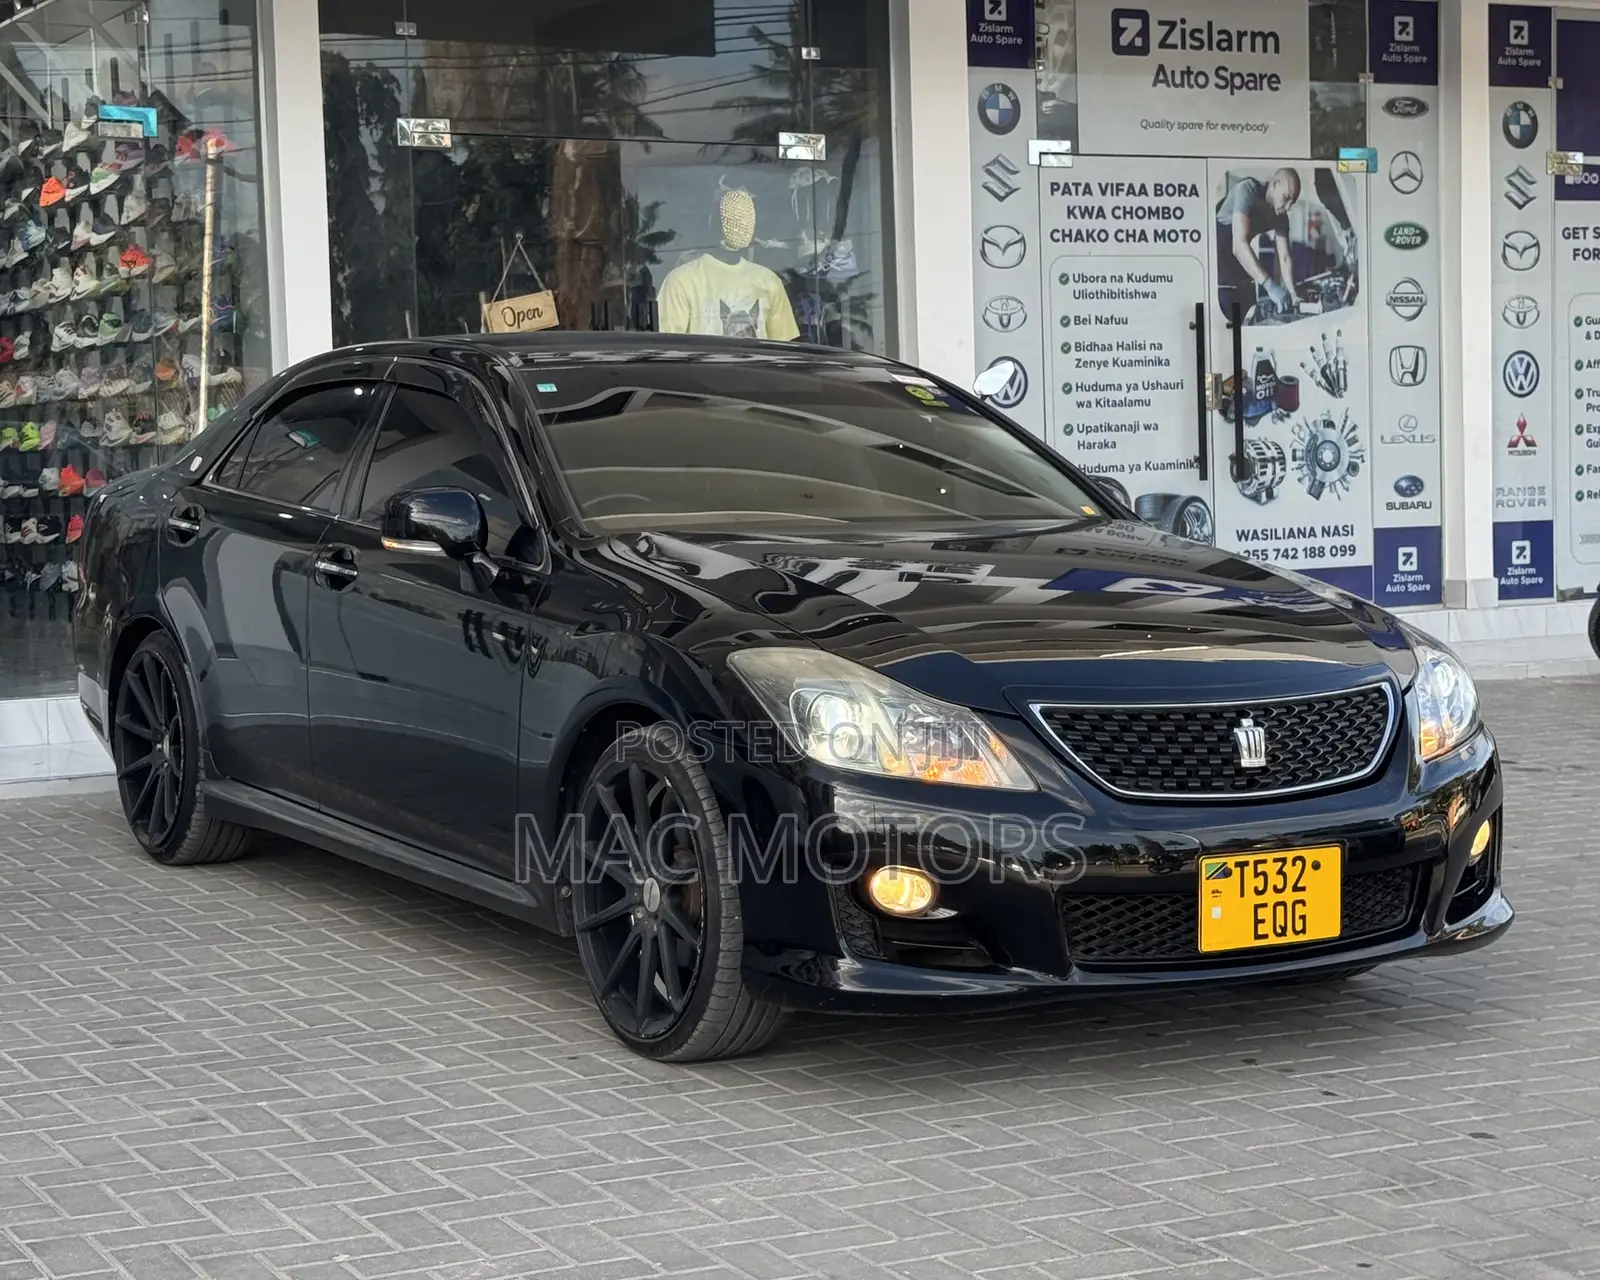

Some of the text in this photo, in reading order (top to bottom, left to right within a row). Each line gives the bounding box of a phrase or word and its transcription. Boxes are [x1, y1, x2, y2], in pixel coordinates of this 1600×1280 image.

[979, 22, 1014, 34] Zislarm
[970, 33, 1024, 46] Auto Spare
[1156, 18, 1280, 54] Zislarm
[1381, 52, 1428, 64] Auto Spare
[1152, 64, 1281, 96] Auto Spare
[1140, 118, 1270, 134] Quality spare for everybody
[1050, 182, 1200, 198] PATA VIFAA BORA
[1066, 205, 1185, 221] KWA CHOMBO
[1049, 229, 1202, 244] CHAKO CHA MOTO
[1393, 227, 1415, 237] LAND
[1562, 226, 1589, 241] GET
[1395, 236, 1422, 246] ROVER
[1572, 247, 1600, 262] FOR
[1072, 273, 1174, 284] Ubora na Kudumu
[1072, 288, 1157, 300] Uliothibitishwa
[1389, 295, 1424, 304] NISSAN
[501, 306, 543, 329] Open
[1073, 315, 1129, 326] Bei Nafuu
[1074, 340, 1163, 352] Bidhaa Halisi na
[1075, 356, 1170, 371] Zenye Kuaminika
[1075, 379, 1184, 395] Huduma ya Ushauri
[1076, 397, 1151, 409] wa Kitaalamu
[1077, 422, 1159, 435] Upatikanaji wa
[1077, 440, 1117, 450] Haraka
[1380, 434, 1436, 444] LEXUS
[1078, 463, 1125, 474] Huduma
[1128, 465, 1142, 475] ya
[1495, 486, 1546, 497] RANGE
[1386, 501, 1432, 511] SUBARU
[1495, 498, 1547, 508] ROVER
[1236, 524, 1355, 542] WASILIANA NASI
[1236, 544, 1357, 561] 255 742 188 099
[1507, 567, 1537, 576] Zislarm
[1392, 573, 1424, 584] Zislarm
[1500, 576, 1544, 587] Auto Spare
[1385, 583, 1431, 595] Auto Spare
[1234, 856, 1307, 899] T532
[1253, 899, 1307, 941] EQG
